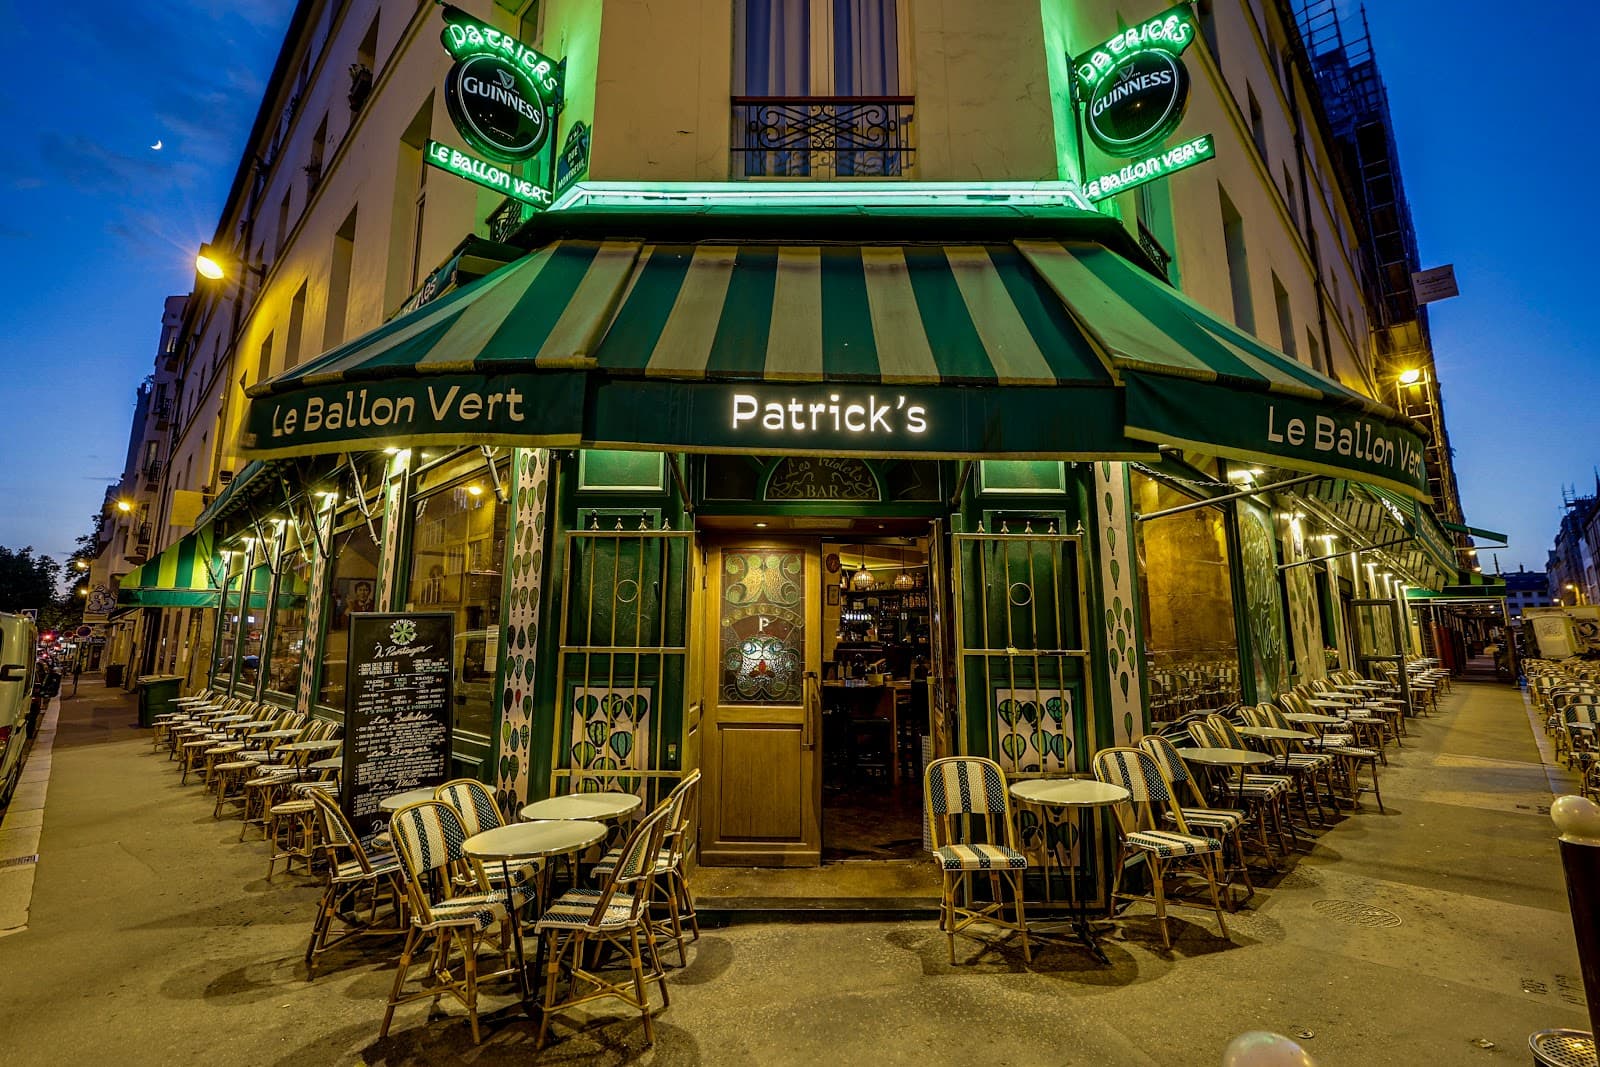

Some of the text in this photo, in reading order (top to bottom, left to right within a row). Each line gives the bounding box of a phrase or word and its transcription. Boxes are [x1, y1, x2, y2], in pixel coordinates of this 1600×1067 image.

[463, 76, 541, 125] GUINNESS
[1092, 70, 1172, 117] GUINNESS
[271, 385, 525, 438] Le Ballon Vert
[732, 394, 927, 433] Patrick's
[1267, 405, 1306, 446] Le
[1315, 415, 1394, 468] Ballon
[806, 484, 839, 498] BAR
